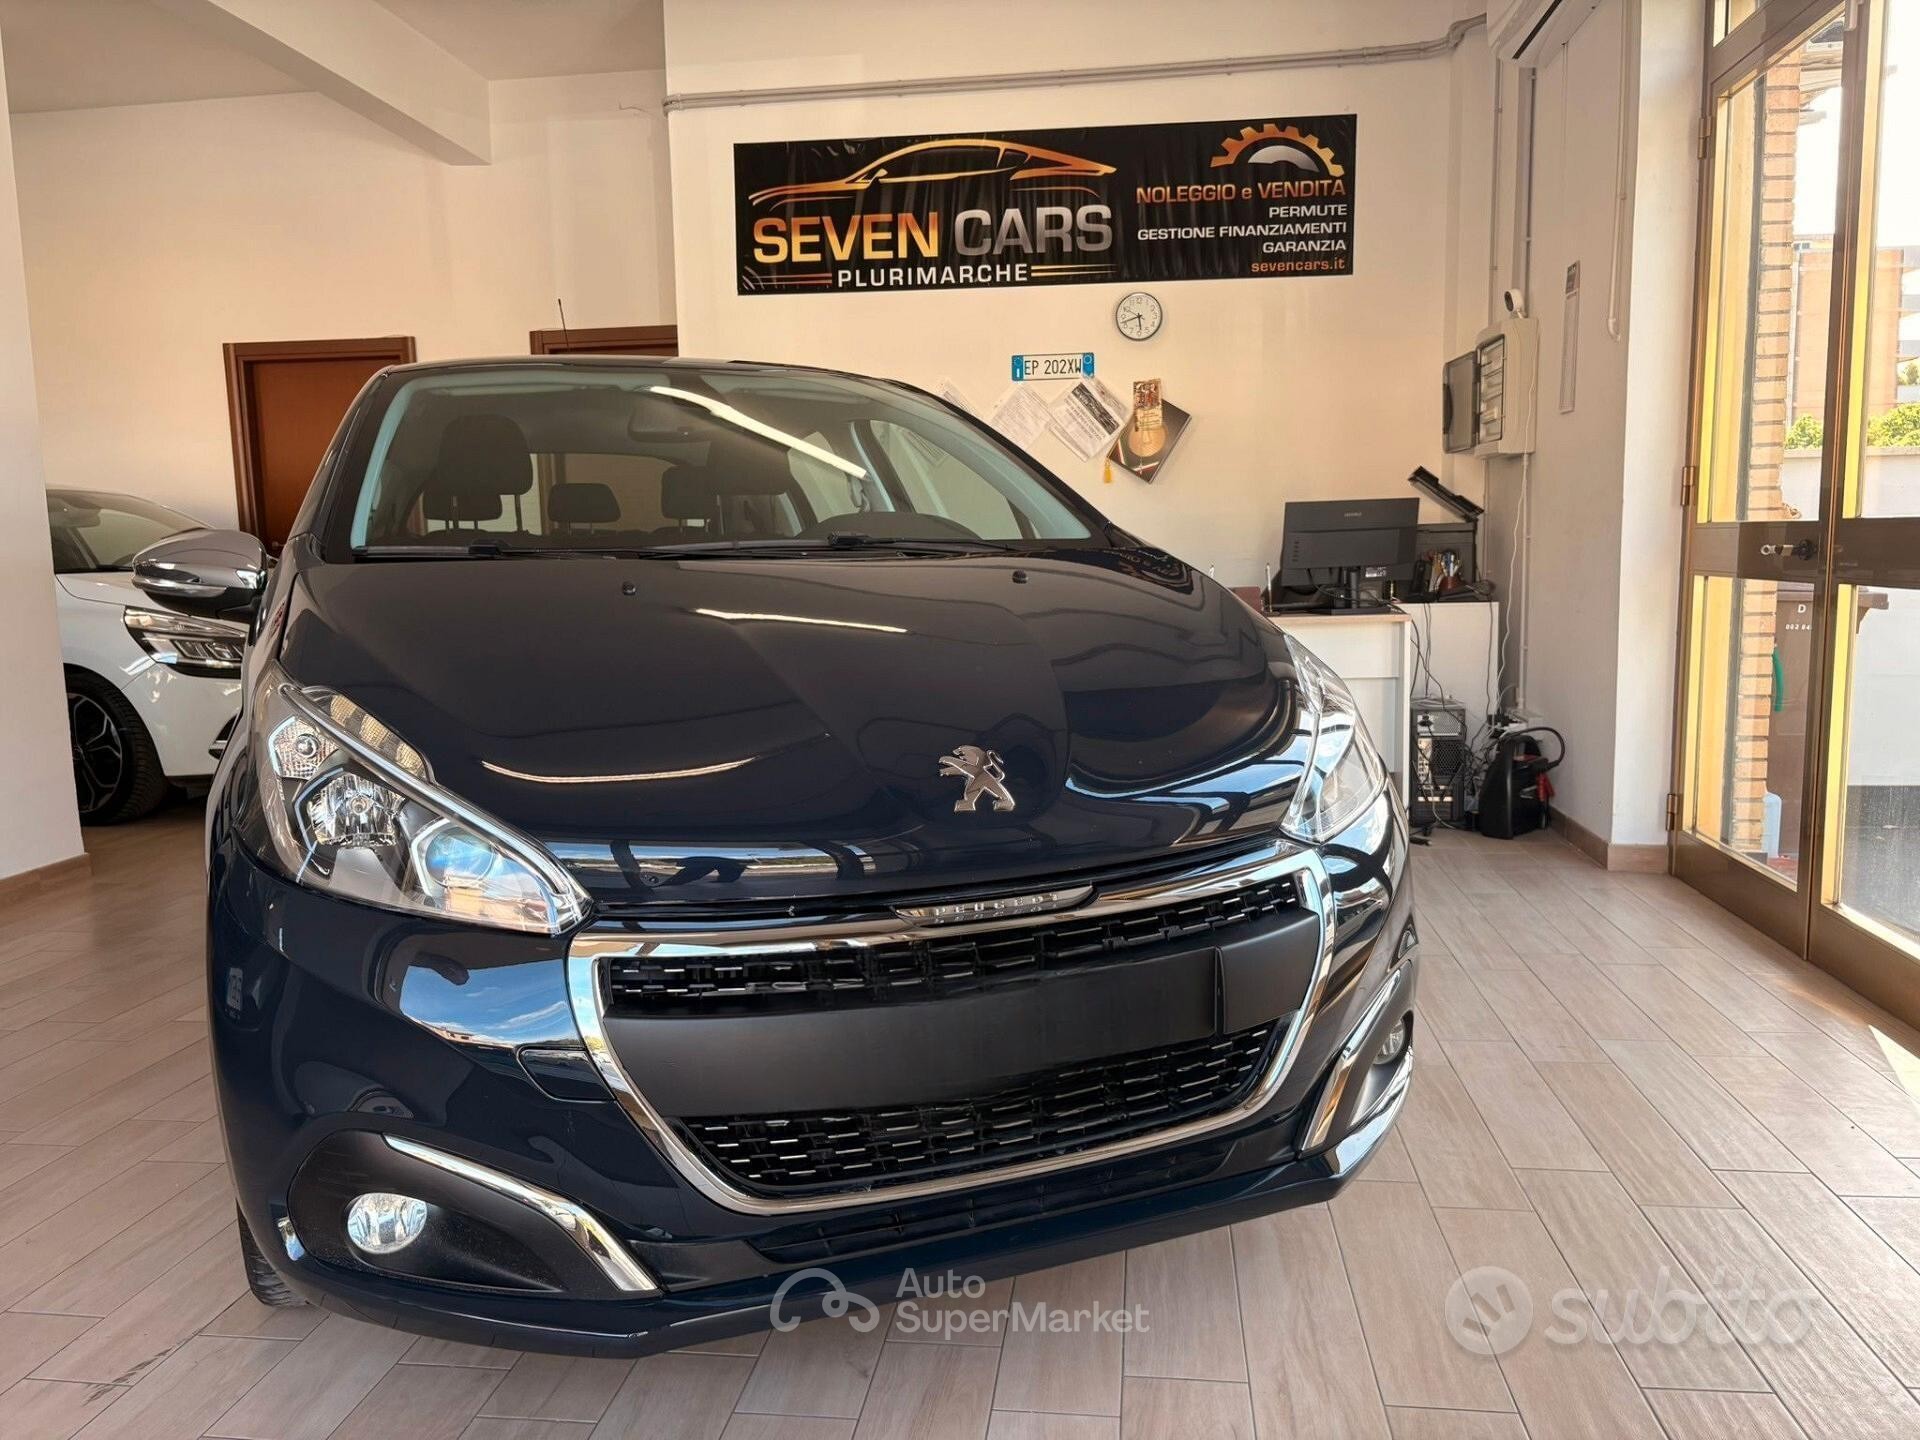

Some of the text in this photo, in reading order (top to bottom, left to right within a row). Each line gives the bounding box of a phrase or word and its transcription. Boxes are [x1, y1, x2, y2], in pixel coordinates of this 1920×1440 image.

[1136, 179, 1346, 204] NOLEGGIO e VENDITA
[1269, 204, 1348, 219] PERMUTE
[753, 205, 1113, 263] SEVEN CARS
[1137, 222, 1347, 241] GESTIONE FINANZIAMENTI
[1262, 240, 1346, 254] GARANZIA
[1251, 257, 1345, 272] sevencars.it
[838, 263, 1028, 287] PLURIMARCHE
[1024, 358, 1082, 375] EP 202XW
[1797, 603, 1807, 614] D
